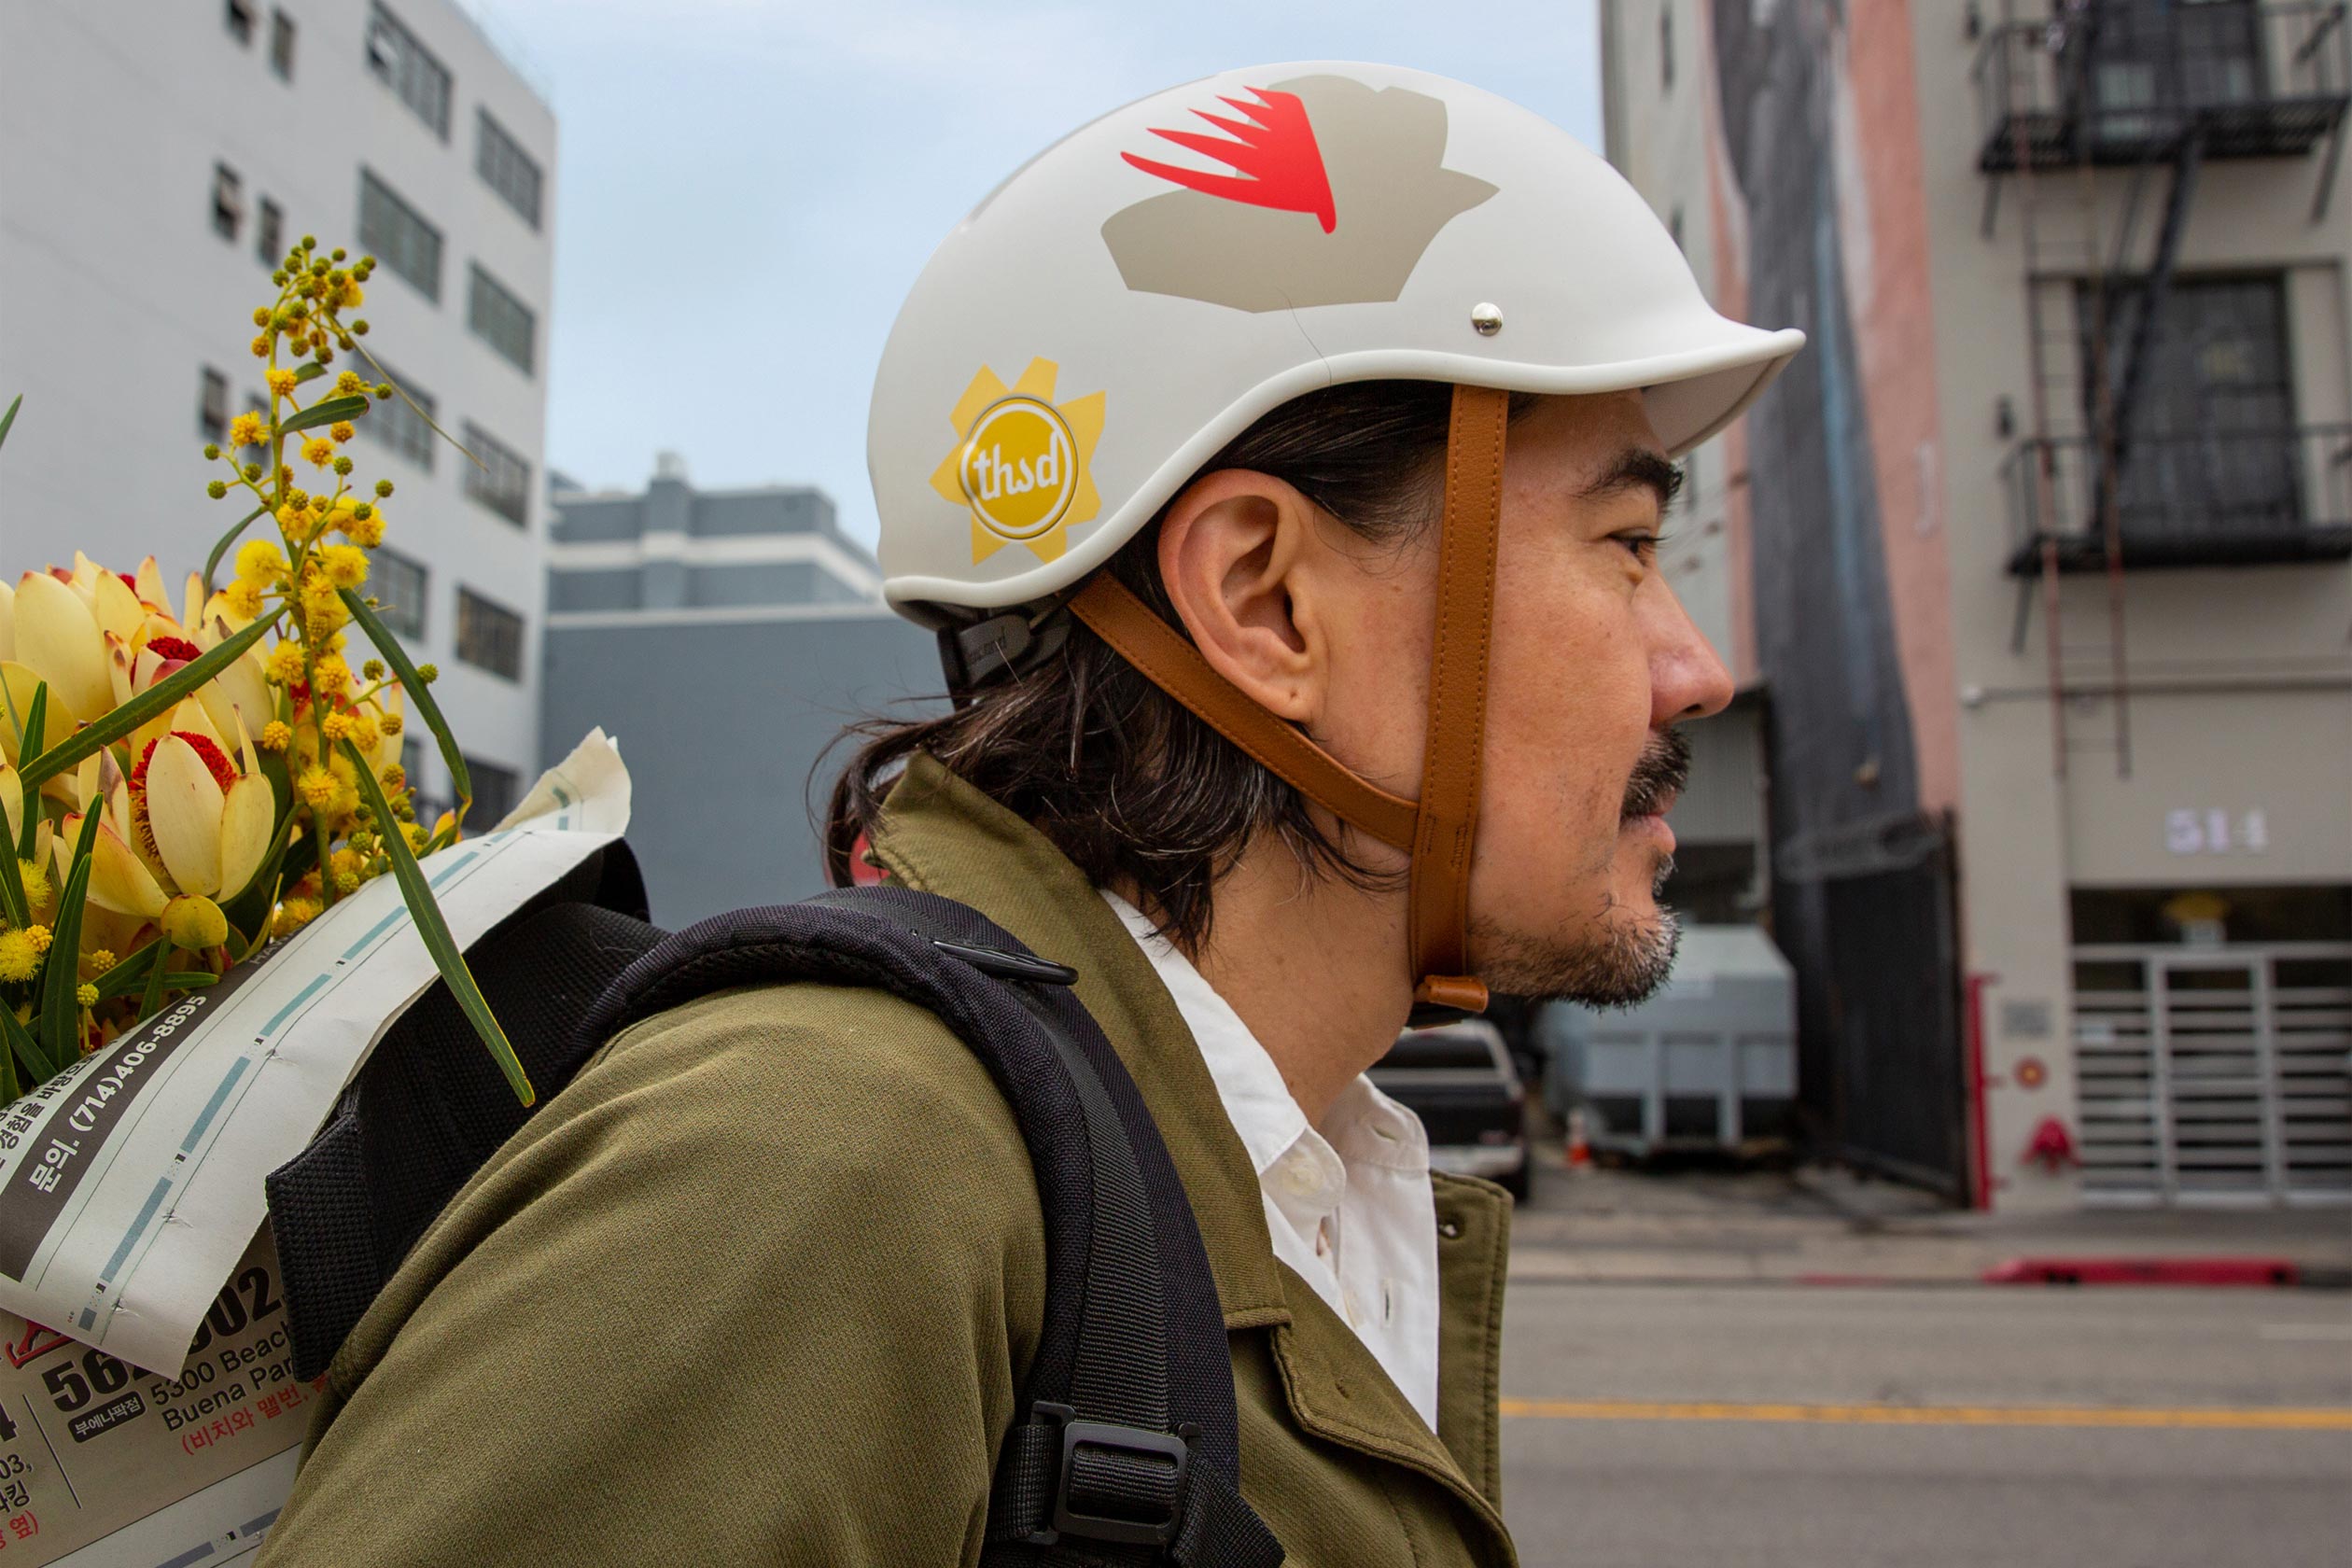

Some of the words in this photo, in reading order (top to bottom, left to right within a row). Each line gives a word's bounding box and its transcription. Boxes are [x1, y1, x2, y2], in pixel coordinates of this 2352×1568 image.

[973, 429, 1059, 501] thsd
[29, 1139, 80, 1194] 문의.
[69, 995, 207, 1132] (714)406-8895
[41, 1347, 153, 1412] 56
[161, 1382, 246, 1431] Buena
[249, 1356, 292, 1391] Par
[75, 1398, 141, 1435] 부에나팍점
[182, 1407, 255, 1455] (비치와
